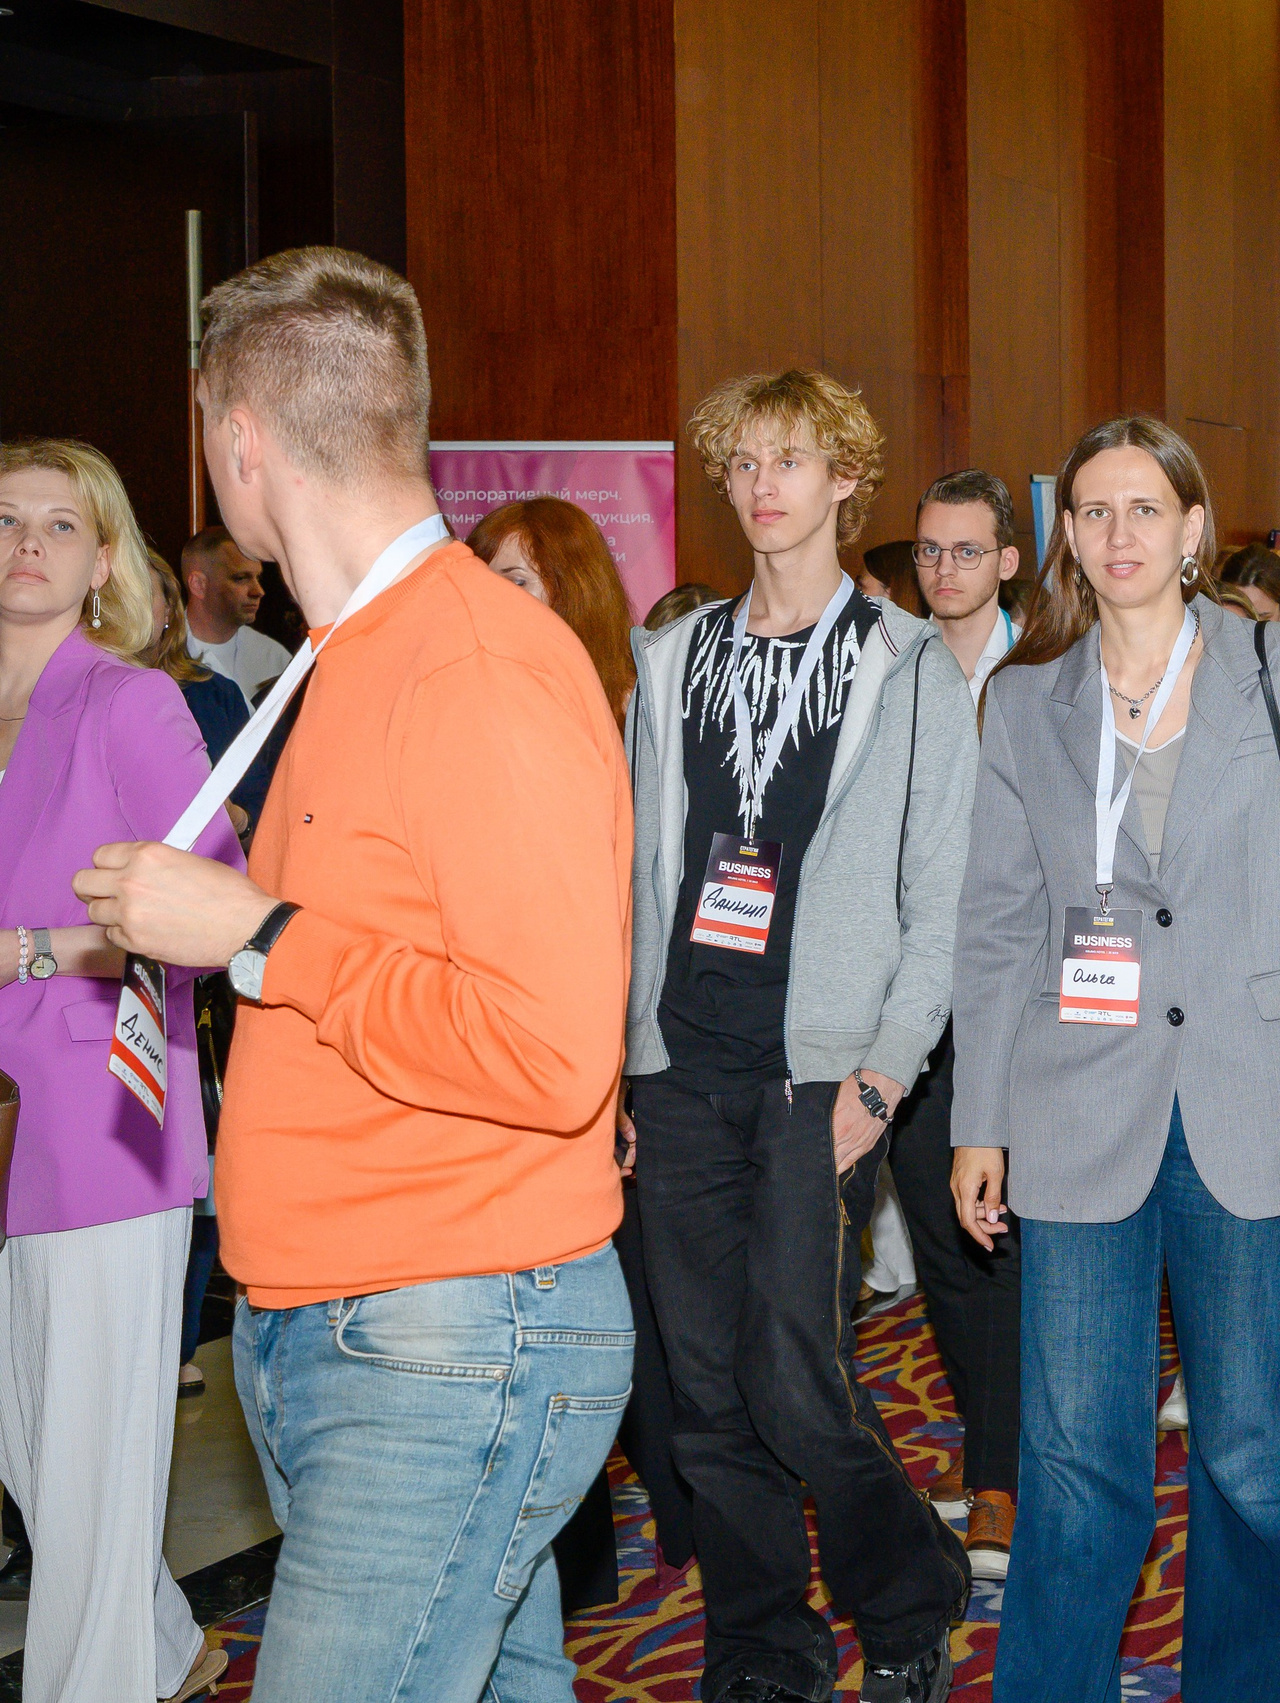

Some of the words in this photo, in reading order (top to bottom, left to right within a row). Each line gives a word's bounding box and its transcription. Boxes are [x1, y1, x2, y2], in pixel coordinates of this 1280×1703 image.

[576, 490, 622, 502] мерч.
[718, 860, 771, 879] BUSINESS
[1074, 934, 1133, 948] BUSINESS
[1073, 968, 1115, 985] Ольга
